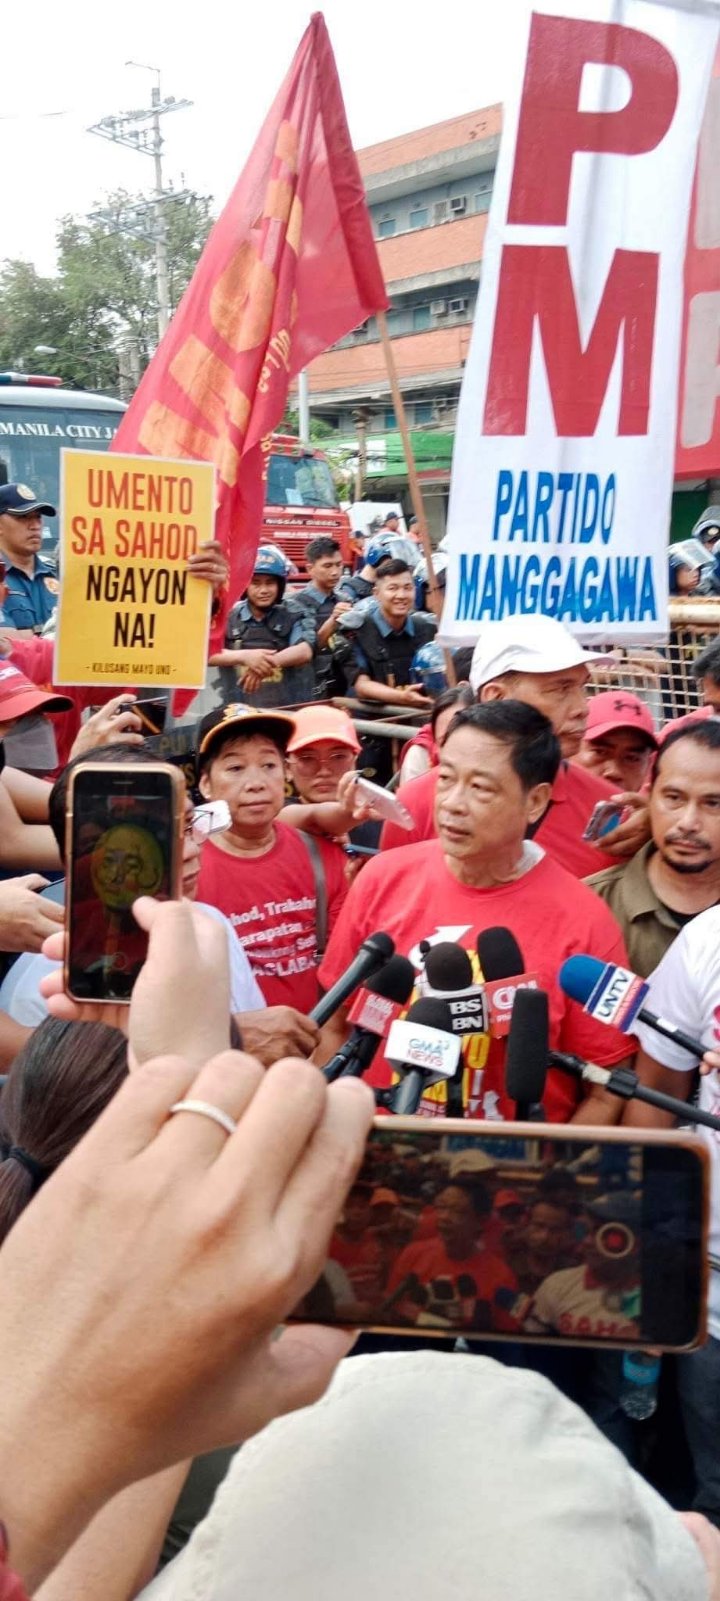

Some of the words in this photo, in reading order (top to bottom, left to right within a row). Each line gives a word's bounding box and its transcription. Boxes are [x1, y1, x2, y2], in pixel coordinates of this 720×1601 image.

[0, 422, 66, 437] MANILA
[66, 424, 101, 439] CITY
[104, 427, 118, 440] J
[87, 468, 193, 515] UMENTO
[492, 470, 616, 545] PARTIDO
[71, 516, 105, 556] SA
[115, 519, 198, 561] SAHOD
[86, 565, 187, 606] NGAYON
[455, 554, 658, 623] MANGGAGAWA
[113, 612, 156, 649] NA!
[131, 663, 154, 675] MAYO
[228, 906, 265, 927] hod,
[239, 922, 302, 947] arapatan
[447, 998, 482, 1015] BS
[597, 971, 629, 1018] UNTV
[451, 1015, 483, 1030] BN
